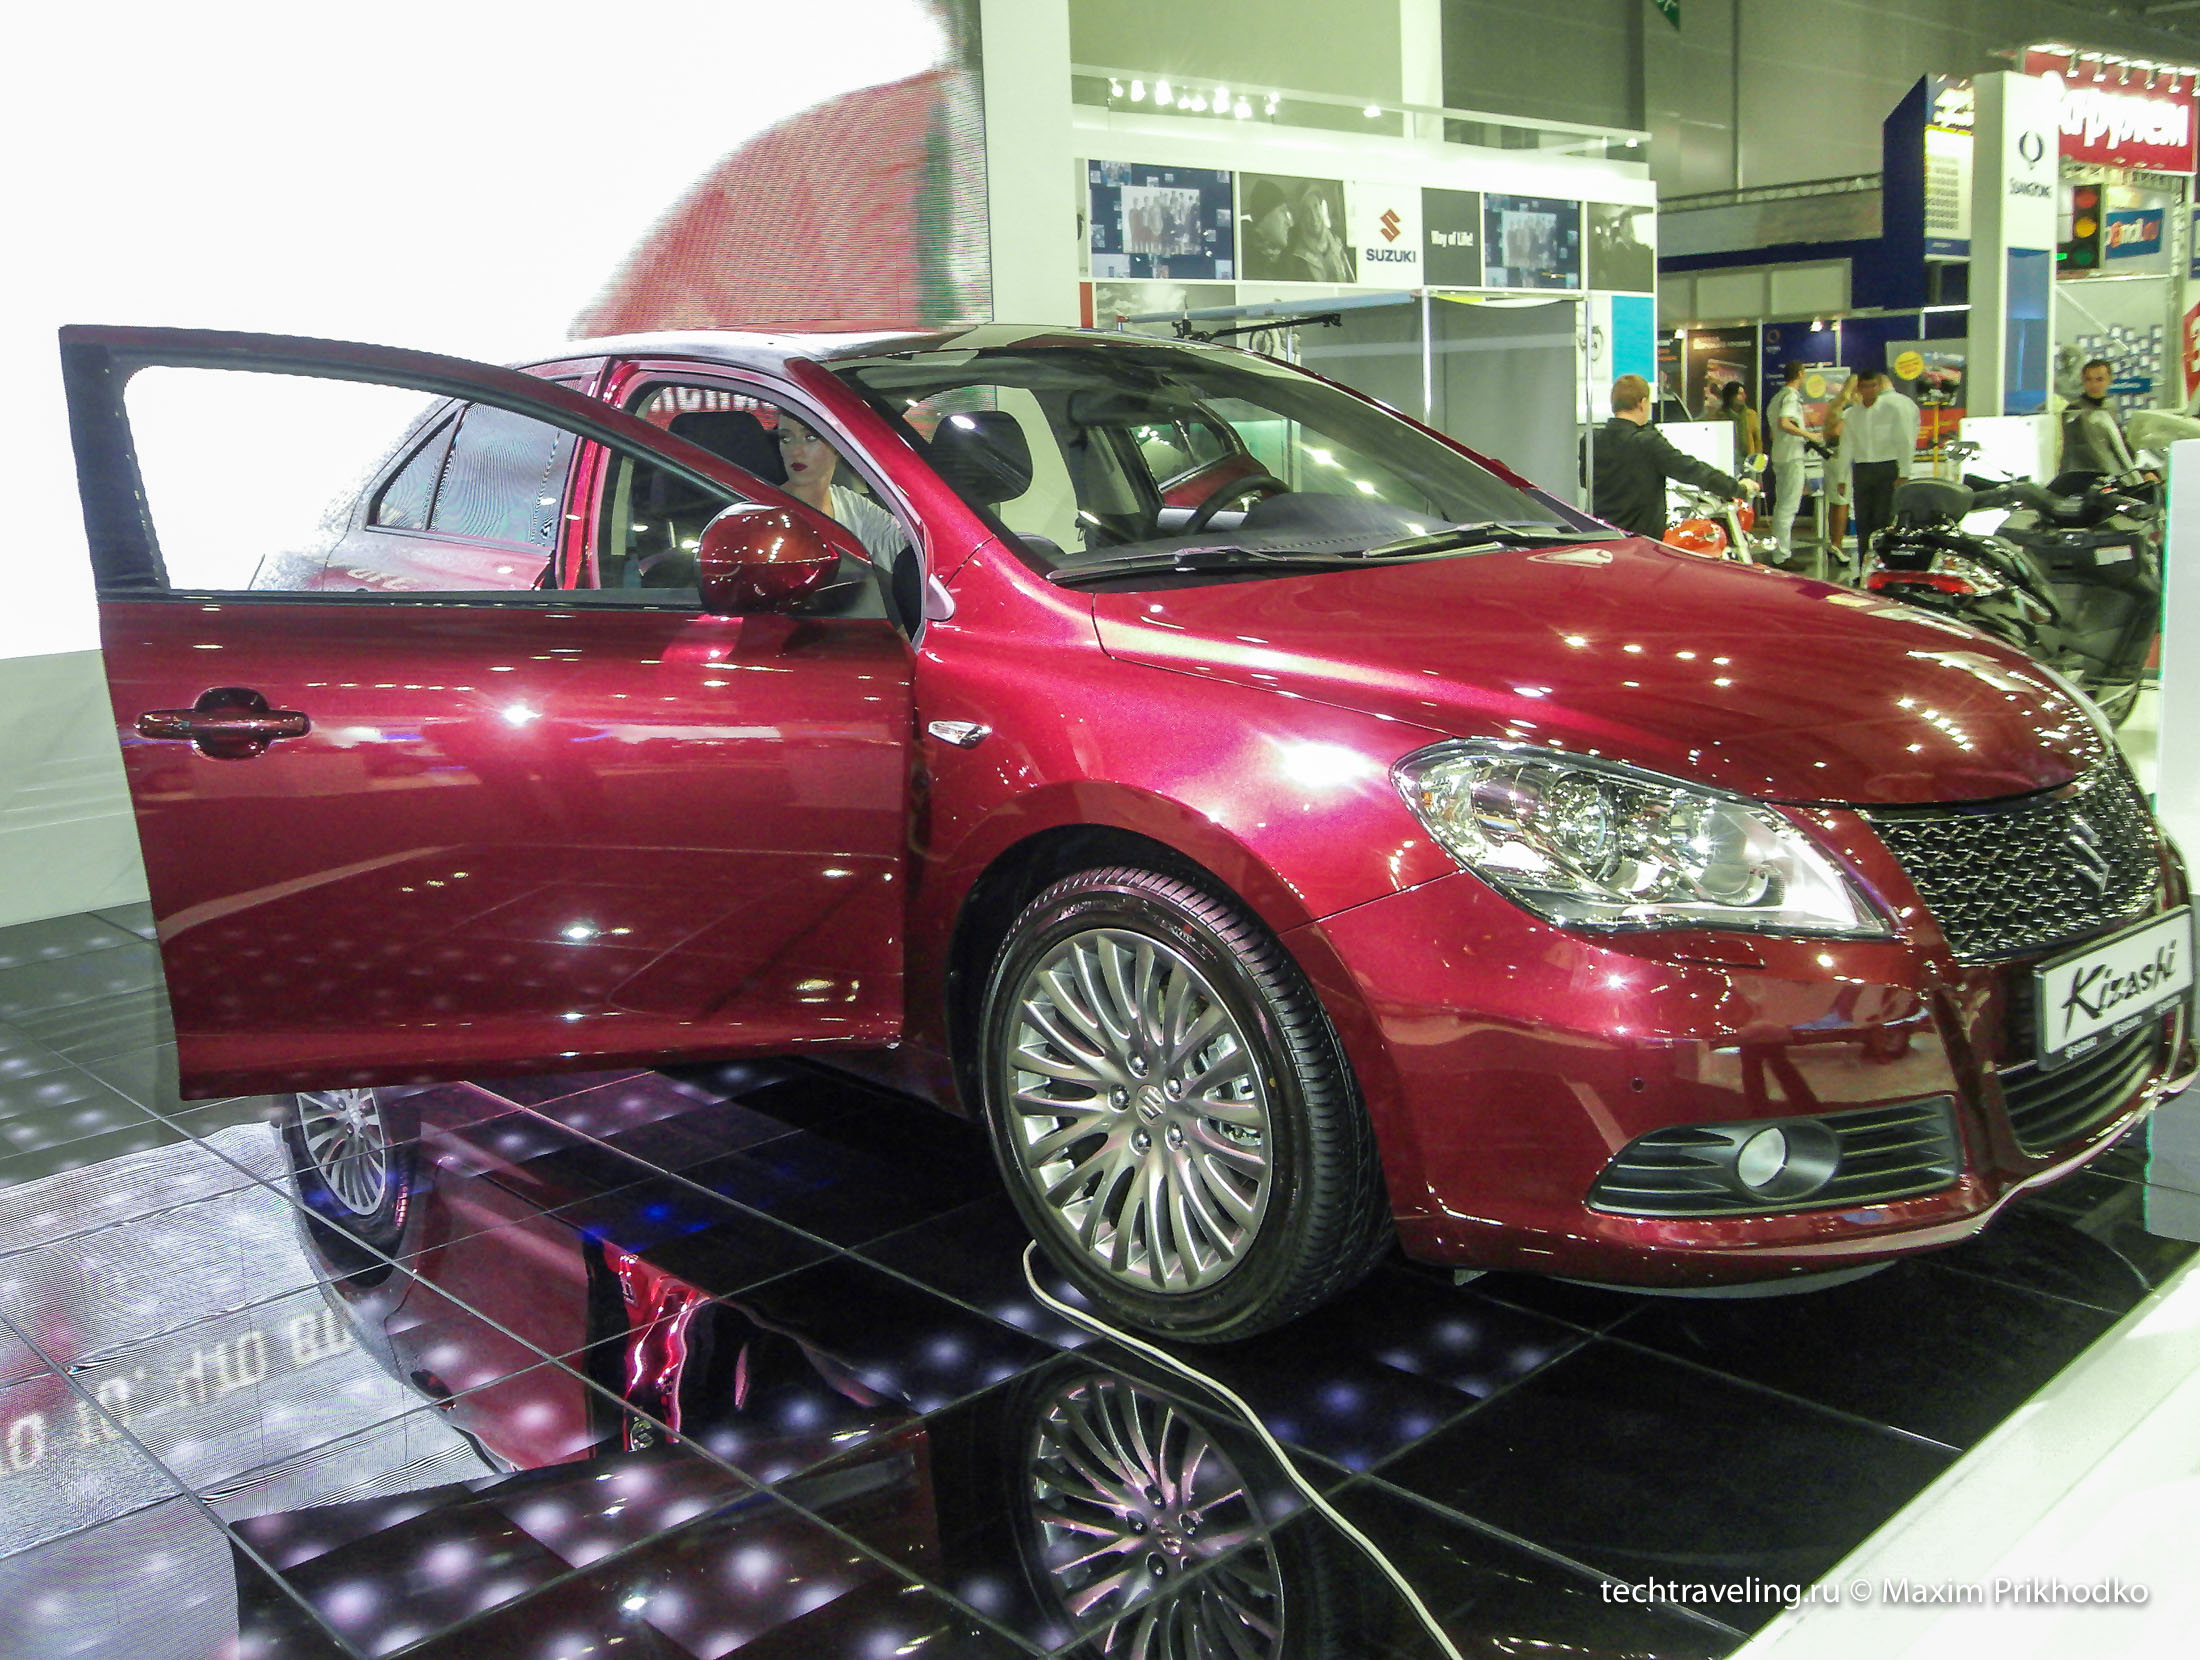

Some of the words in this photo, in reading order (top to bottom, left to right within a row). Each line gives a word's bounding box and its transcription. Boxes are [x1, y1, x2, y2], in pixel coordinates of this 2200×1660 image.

[1448, 231, 1456, 246] of
[1366, 248, 1416, 263] SUZUKI
[2061, 939, 2176, 1038] Kizashi
